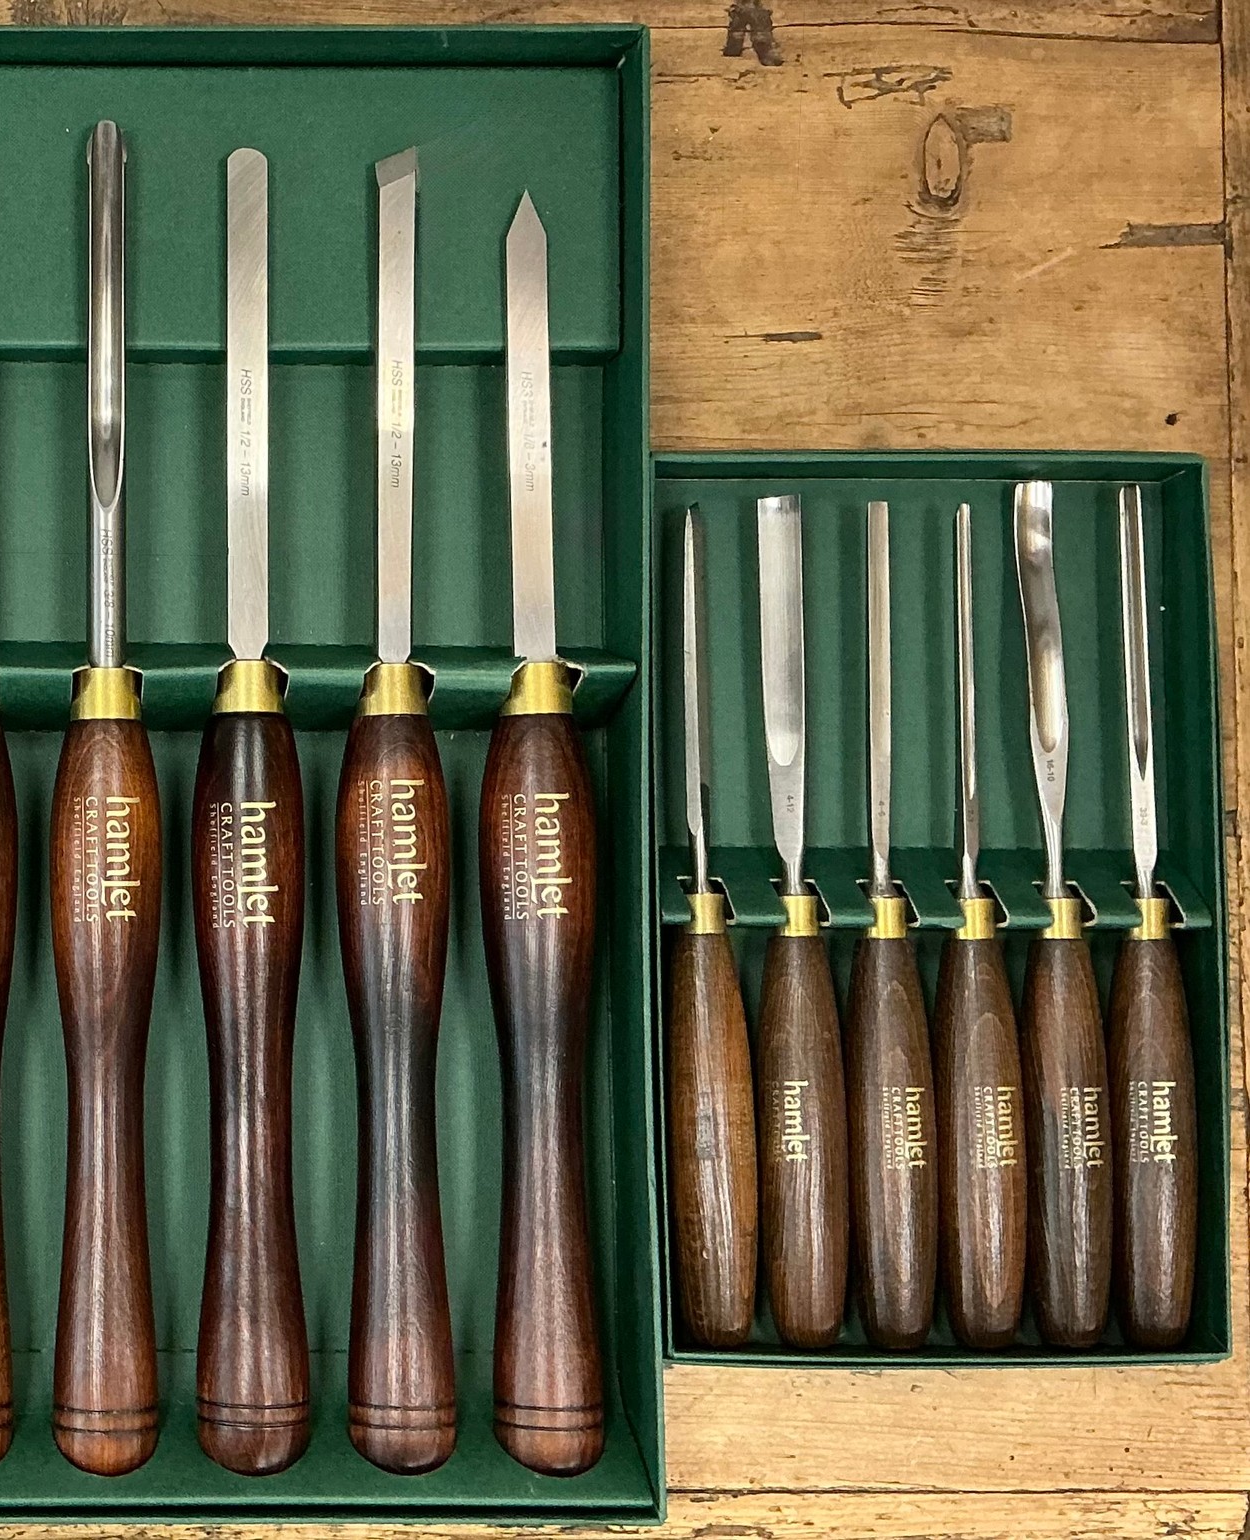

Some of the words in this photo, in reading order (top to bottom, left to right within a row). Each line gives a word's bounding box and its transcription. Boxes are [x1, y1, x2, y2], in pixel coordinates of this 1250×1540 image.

[240, 368, 251, 395] HSS
[392, 360, 402, 386] HSS
[240, 430, 250, 448] 1/2
[391, 421, 402, 439] 1/2
[240, 462, 251, 496] 13mm
[391, 454, 402, 488] 13mm
[101, 528, 113, 555] HSS
[86, 796, 98, 856] CRAFT
[209, 804, 218, 866] Sheffield
[220, 802, 234, 862] CRAFT
[358, 780, 367, 842] Sheffield
[370, 780, 384, 840] CRAFT
[514, 793, 527, 853] CRAFT
[100, 796, 140, 922] hamlet
[236, 801, 279, 928] hamlet
[386, 779, 428, 905] hamlet
[530, 792, 573, 920] hamlet
[86, 862, 100, 922] TOOLS
[210, 875, 219, 928] England
[222, 868, 236, 928] TOOLS
[358, 852, 368, 906] England
[372, 844, 384, 905] TOOLS
[515, 858, 529, 920] TOOLS
[782, 1080, 811, 1162] hamlet
[892, 1086, 903, 1127] CRAFT
[905, 1086, 928, 1170] hamlet
[983, 1086, 995, 1128] CRAFT
[995, 1086, 1019, 1168] hamlet
[1070, 1087, 1082, 1126] CRAFT
[1083, 1086, 1106, 1168] hamlet
[1138, 1081, 1149, 1120] CRAFT
[1150, 1081, 1178, 1164] hamlet
[894, 1129, 905, 1170] TOOLS
[985, 1130, 997, 1169] TOOLS
[1072, 1130, 1083, 1169] TOOLS
[1139, 1124, 1150, 1164] TOOLS
